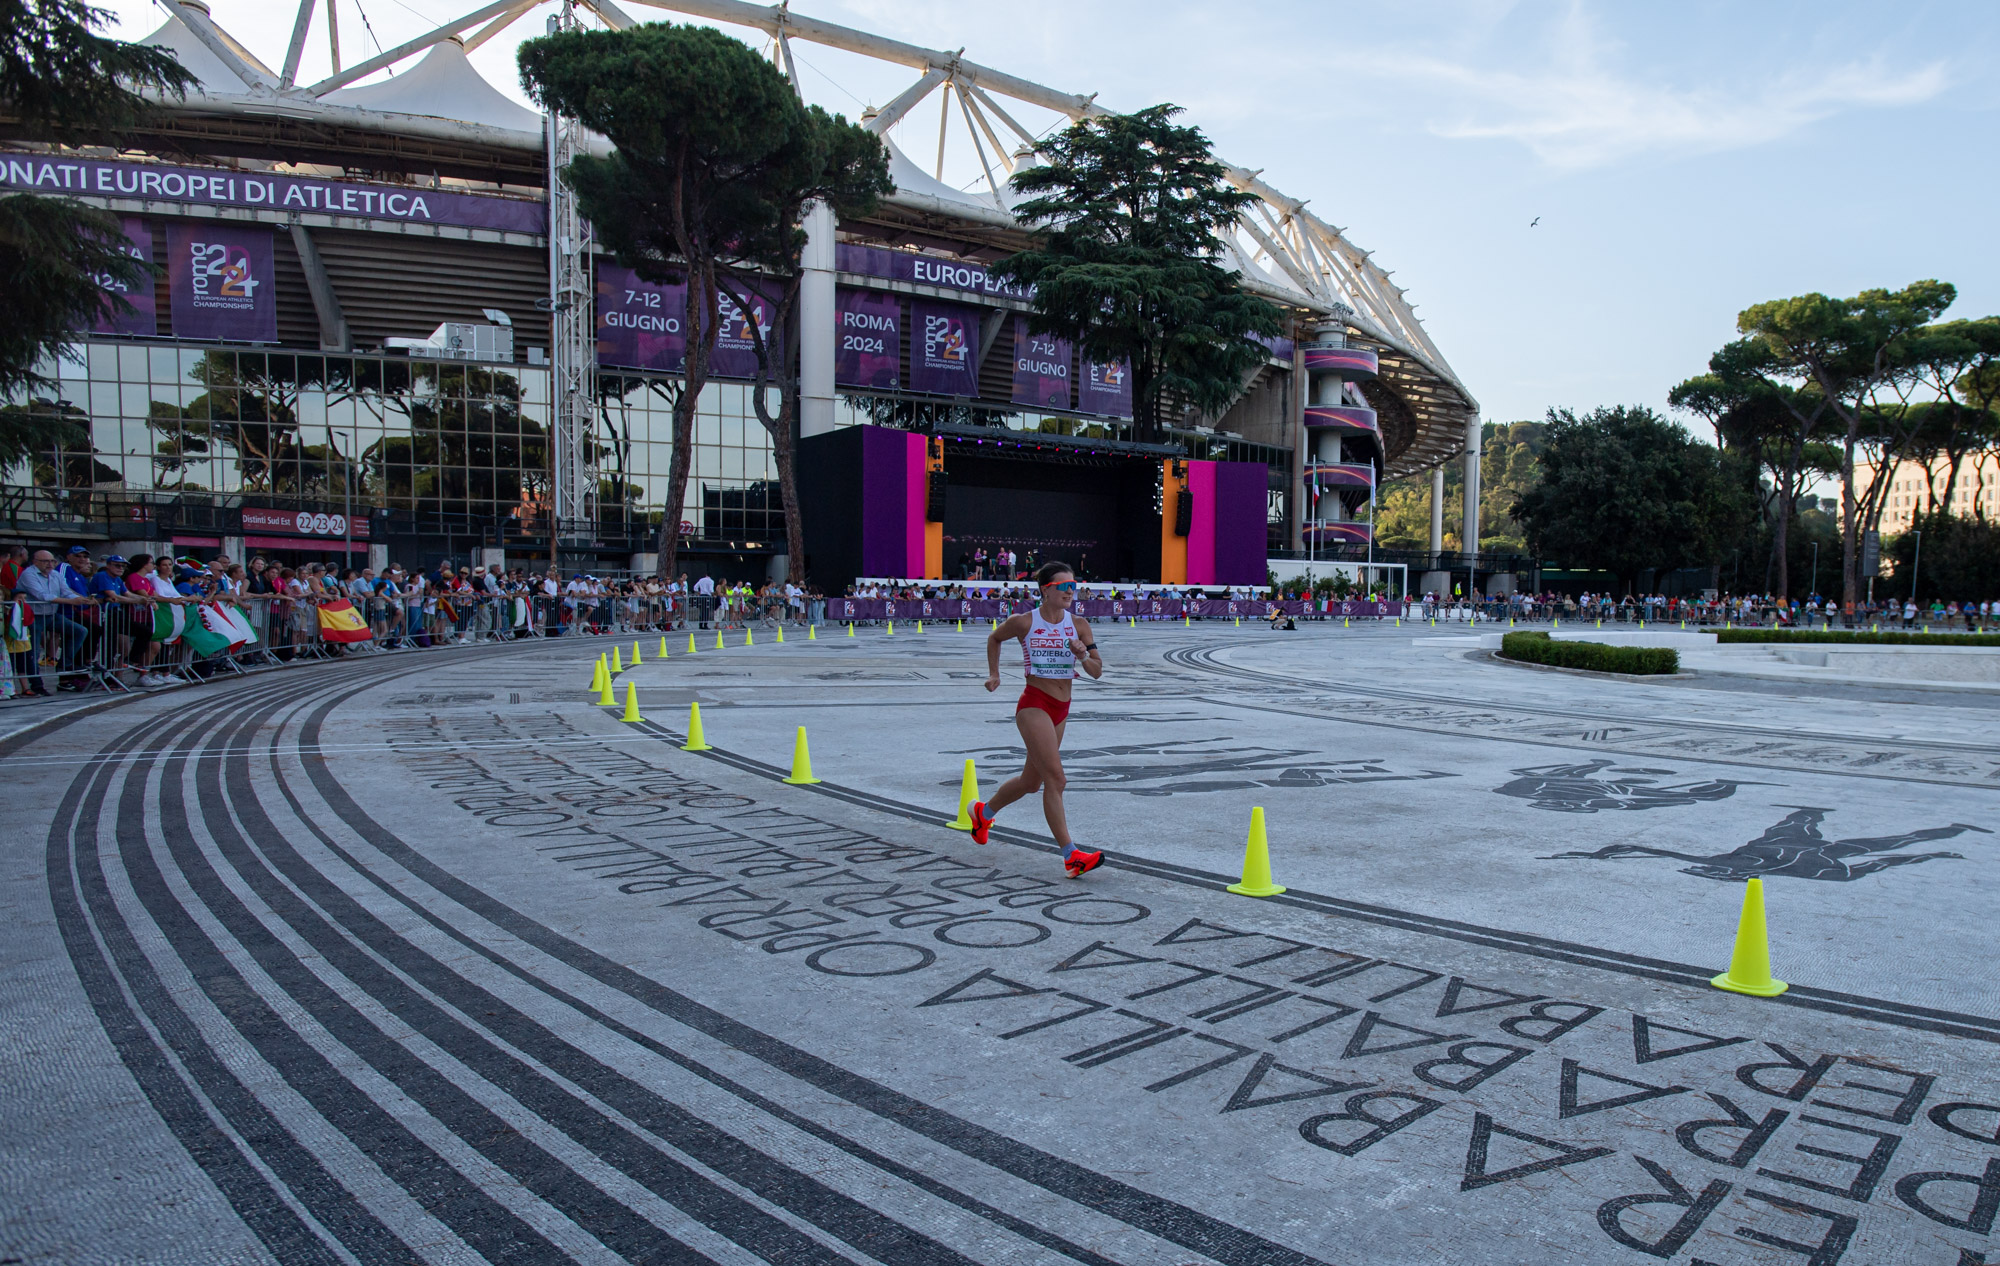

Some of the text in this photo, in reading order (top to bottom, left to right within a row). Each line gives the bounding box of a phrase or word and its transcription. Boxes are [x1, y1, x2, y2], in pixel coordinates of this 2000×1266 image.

[97, 168, 235, 200] EUROPEI
[245, 180, 275, 204] DI
[283, 184, 431, 218] ATLETICA
[191, 243, 209, 294] roma
[193, 301, 254, 310] CHAMPIONSHIPS
[625, 289, 661, 308] 7-12
[605, 311, 680, 333] GIUGNO
[925, 315, 936, 358] roma
[843, 335, 884, 353] 2024
[1032, 340, 1056, 356] 7-12
[925, 362, 965, 371] CHAMPIONSHIPS
[1018, 358, 1067, 377] GIUGNO
[242, 514, 266, 524] Distinti
[267, 517, 280, 525] Sud
[280, 517, 291, 526] Est
[299, 516, 311, 529] 22
[316, 517, 327, 530] 23
[332, 519, 344, 531] 24
[680, 522, 692, 534] 22
[1031, 639, 1062, 647] SPAR
[517, 824, 728, 894] BALILLA
[621, 815, 837, 878] BALILLA
[787, 869, 1051, 948] OPERA
[894, 855, 1151, 925] OPERA
[661, 884, 936, 977] OPERA
[1153, 918, 1607, 1043] BALILLA
[1048, 941, 1536, 1093] BALILLA
[914, 968, 1446, 1157] BALILLA
